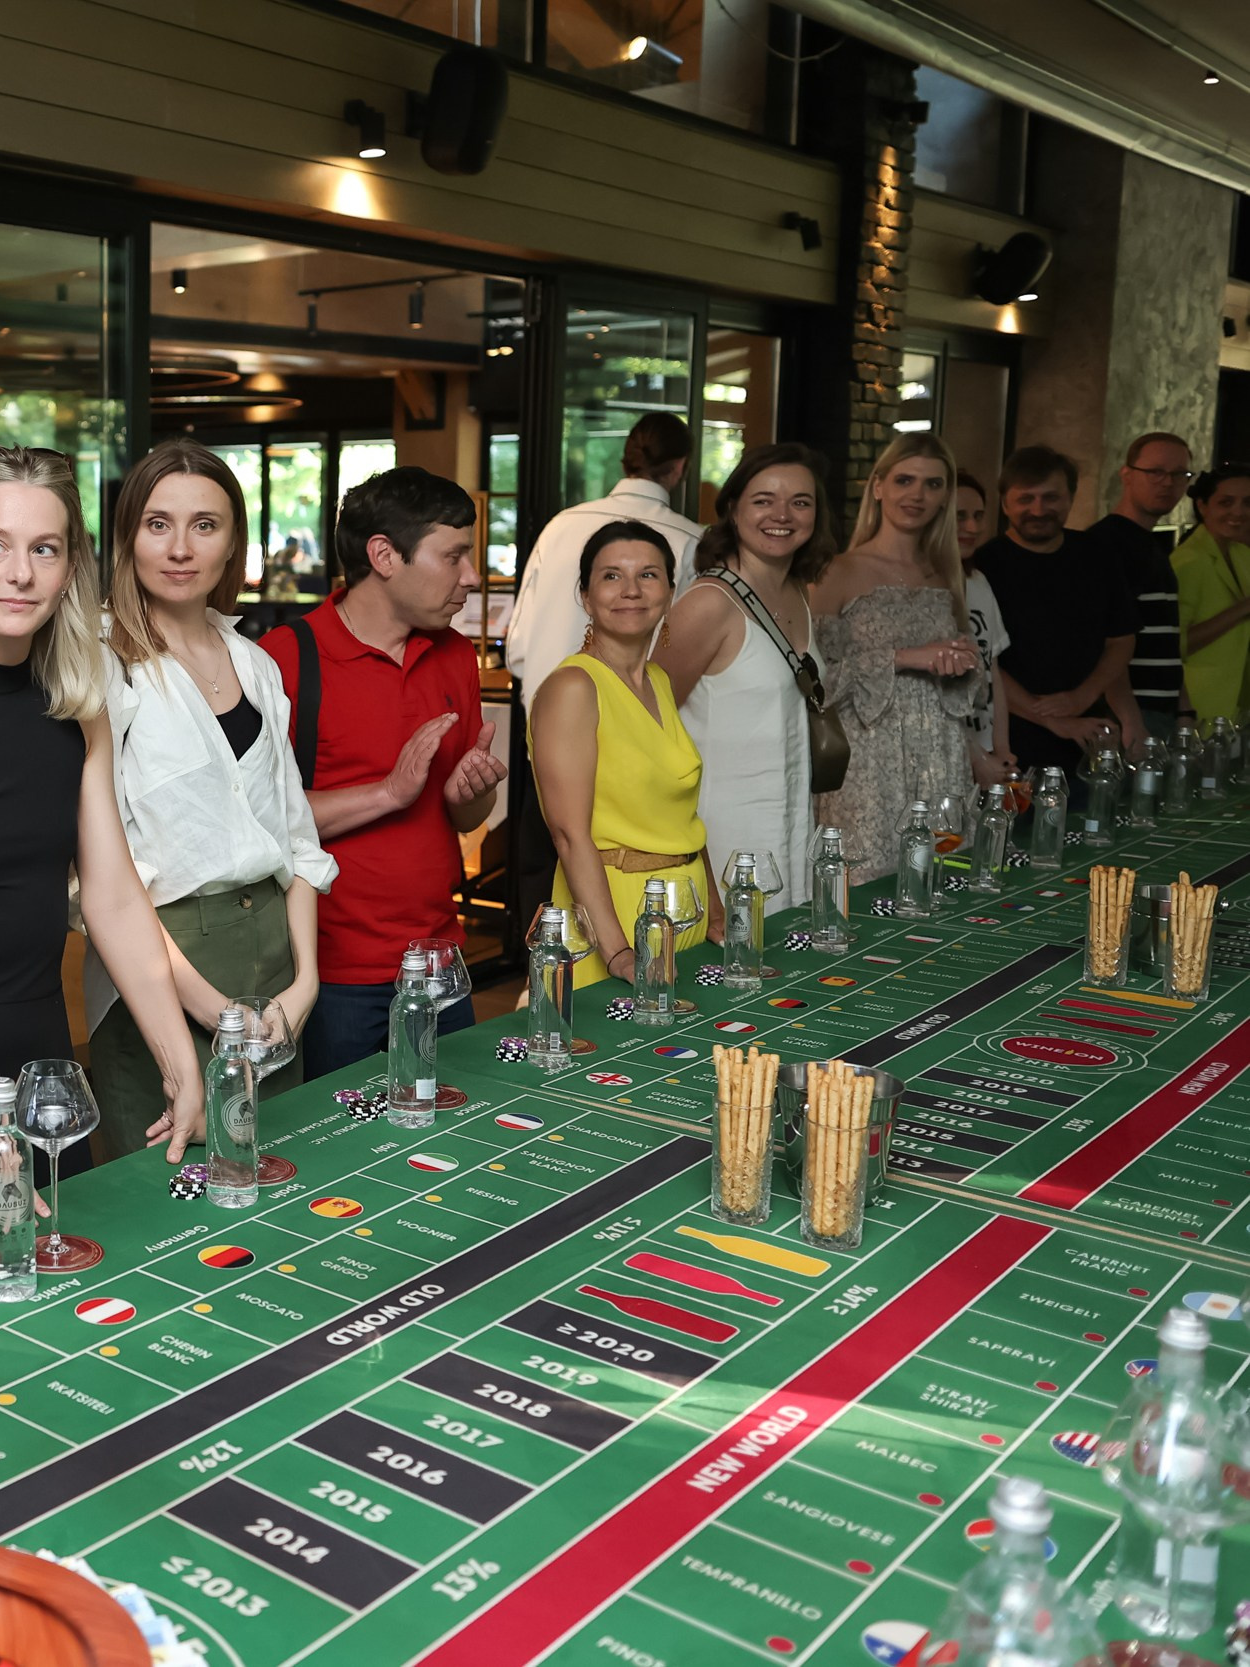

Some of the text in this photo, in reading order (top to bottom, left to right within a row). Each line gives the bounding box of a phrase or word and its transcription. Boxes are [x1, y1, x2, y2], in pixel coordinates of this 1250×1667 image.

[814, 1018, 870, 1031] MOSCATO
[894, 1013, 951, 1042] OLD WORLD
[1015, 1041, 1105, 1061] WINE ON
[969, 1079, 1029, 1095] 2019
[997, 1068, 1056, 1086] 2020
[1177, 1062, 1230, 1096] NEW WORLD
[453, 1100, 492, 1117] France
[933, 1101, 994, 1117] 2017
[951, 1089, 1010, 1105] 2018
[296, 1122, 321, 1134] GAME
[319, 1111, 347, 1126] CARDS
[332, 1123, 359, 1137] WORLD
[914, 1112, 974, 1129] 2016
[272, 1133, 294, 1145] WINE
[309, 1135, 327, 1146] ALC.
[565, 1124, 653, 1151] CHARDONNAY
[895, 1123, 955, 1141] 2015
[370, 1140, 400, 1155] Italy
[890, 1139, 935, 1153] 014
[1175, 1142, 1219, 1155] PINOT
[519, 1149, 596, 1174] SAUVIGNON
[528, 1159, 571, 1175] BLANC
[268, 1182, 307, 1201] Spain
[1157, 1172, 1219, 1190] MERLOT
[465, 1186, 519, 1206] RIESLING
[1101, 1200, 1204, 1228] SAUVIGNON
[1117, 1197, 1201, 1221] CABERNET
[144, 1224, 209, 1254] Germany
[396, 1218, 457, 1243] VIOGNIER
[320, 1260, 369, 1280] GRIGIO
[336, 1255, 377, 1274] PINOT
[1064, 1247, 1151, 1276] CABERNET
[1069, 1257, 1130, 1278] FRANC
[28, 1278, 82, 1303] Austria
[235, 1292, 304, 1321] MOSCATO
[326, 1284, 446, 1346] OLD WORLD
[1018, 1292, 1102, 1320] ZWEIGELT
[147, 1342, 195, 1366] BLANC
[160, 1334, 213, 1360] CHENIN
[575, 1329, 656, 1363] 2020
[967, 1336, 1057, 1368] SAPERAVI
[521, 1355, 600, 1387] 2019
[47, 1380, 116, 1416] RKATSITELI
[473, 1383, 553, 1418] 2018
[919, 1392, 988, 1419] SHIRAZ
[925, 1383, 999, 1412] SYRAH/
[422, 1413, 506, 1449] 2017
[179, 1439, 244, 1474] 12%
[686, 1404, 810, 1493] NEW WORLD
[855, 1439, 939, 1473] MALBEC
[366, 1444, 449, 1486] 2016
[308, 1480, 393, 1523] 2015
[762, 1489, 896, 1546] SANGIOVESE
[243, 1517, 331, 1565] 2014
[181, 1566, 271, 1617] 2013
[431, 1556, 502, 1602] 13%
[680, 1554, 823, 1622] TEMPRANILLO
